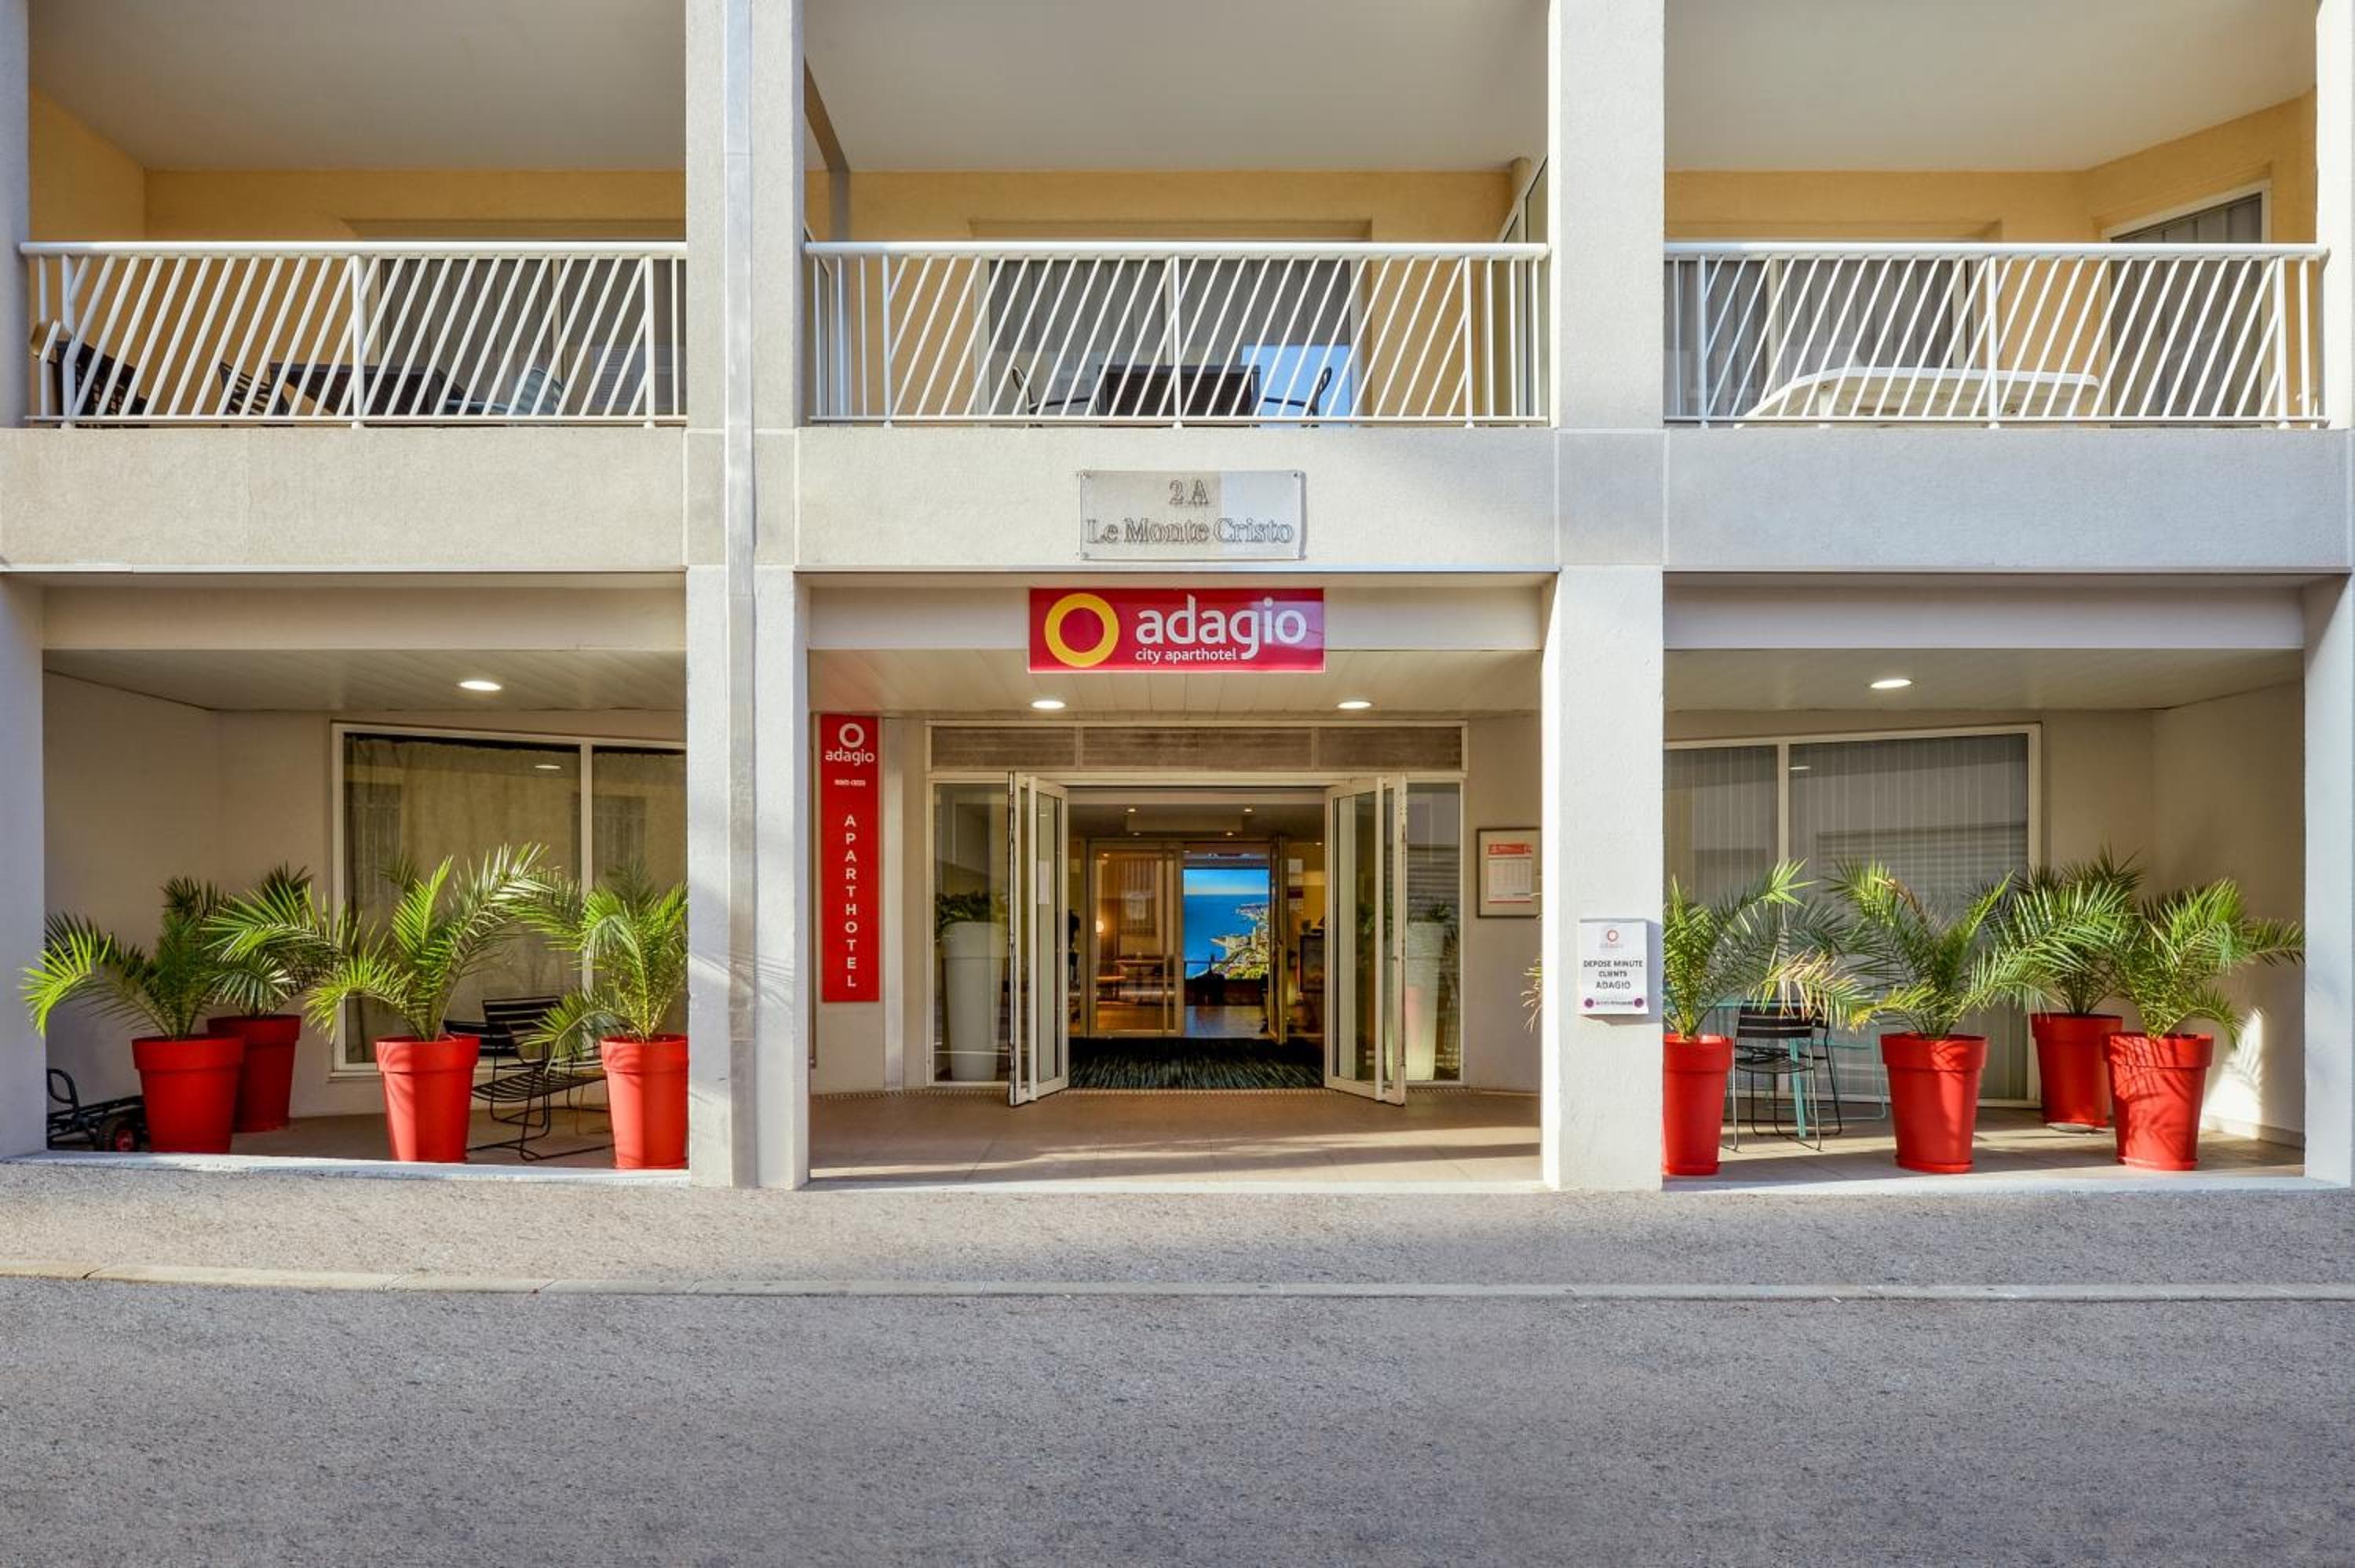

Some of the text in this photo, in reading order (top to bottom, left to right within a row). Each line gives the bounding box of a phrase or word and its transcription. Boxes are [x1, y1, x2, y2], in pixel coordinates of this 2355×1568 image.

[1169, 480, 1209, 505] 2 A
[1086, 518, 1294, 543] Le Monte Cristo
[1135, 594, 1308, 659] adagio
[1135, 648, 1237, 663] city aparthotel
[825, 747, 875, 766] adagio
[844, 815, 858, 987] APARTHOTEL
[1596, 981, 1631, 990] ADAGIO
